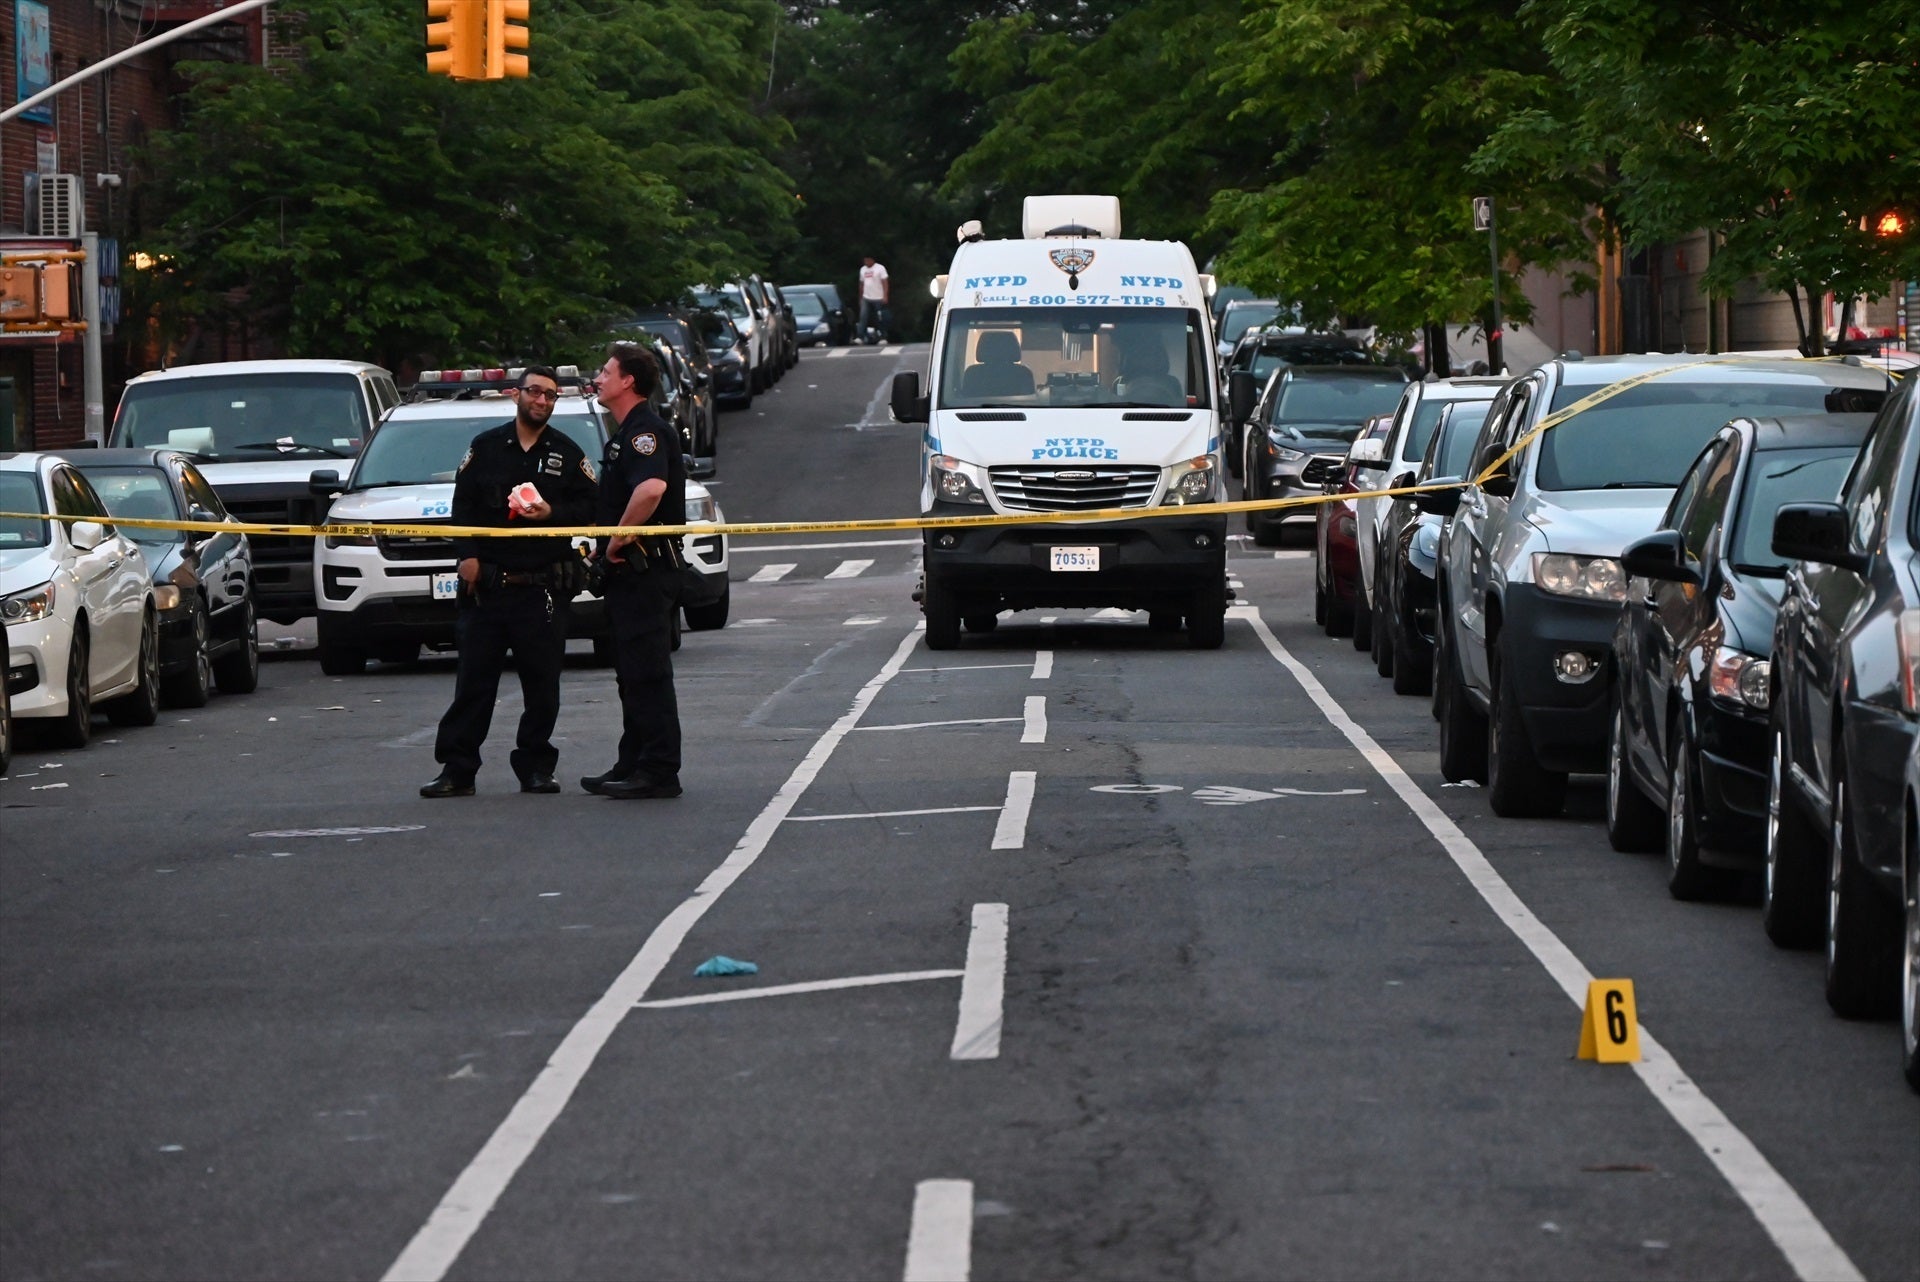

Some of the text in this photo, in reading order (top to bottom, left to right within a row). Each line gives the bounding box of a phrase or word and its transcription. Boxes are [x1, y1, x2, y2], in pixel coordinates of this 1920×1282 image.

[965, 275, 1028, 290] NYPD
[1120, 275, 1184, 290] NYPD
[1010, 294, 1166, 306] 1-800-577-TIPS
[1045, 438, 1105, 447] NYPD
[1031, 446, 1119, 460] POLICE
[1055, 553, 1086, 565] 7053
[1605, 988, 1629, 1046] 6
